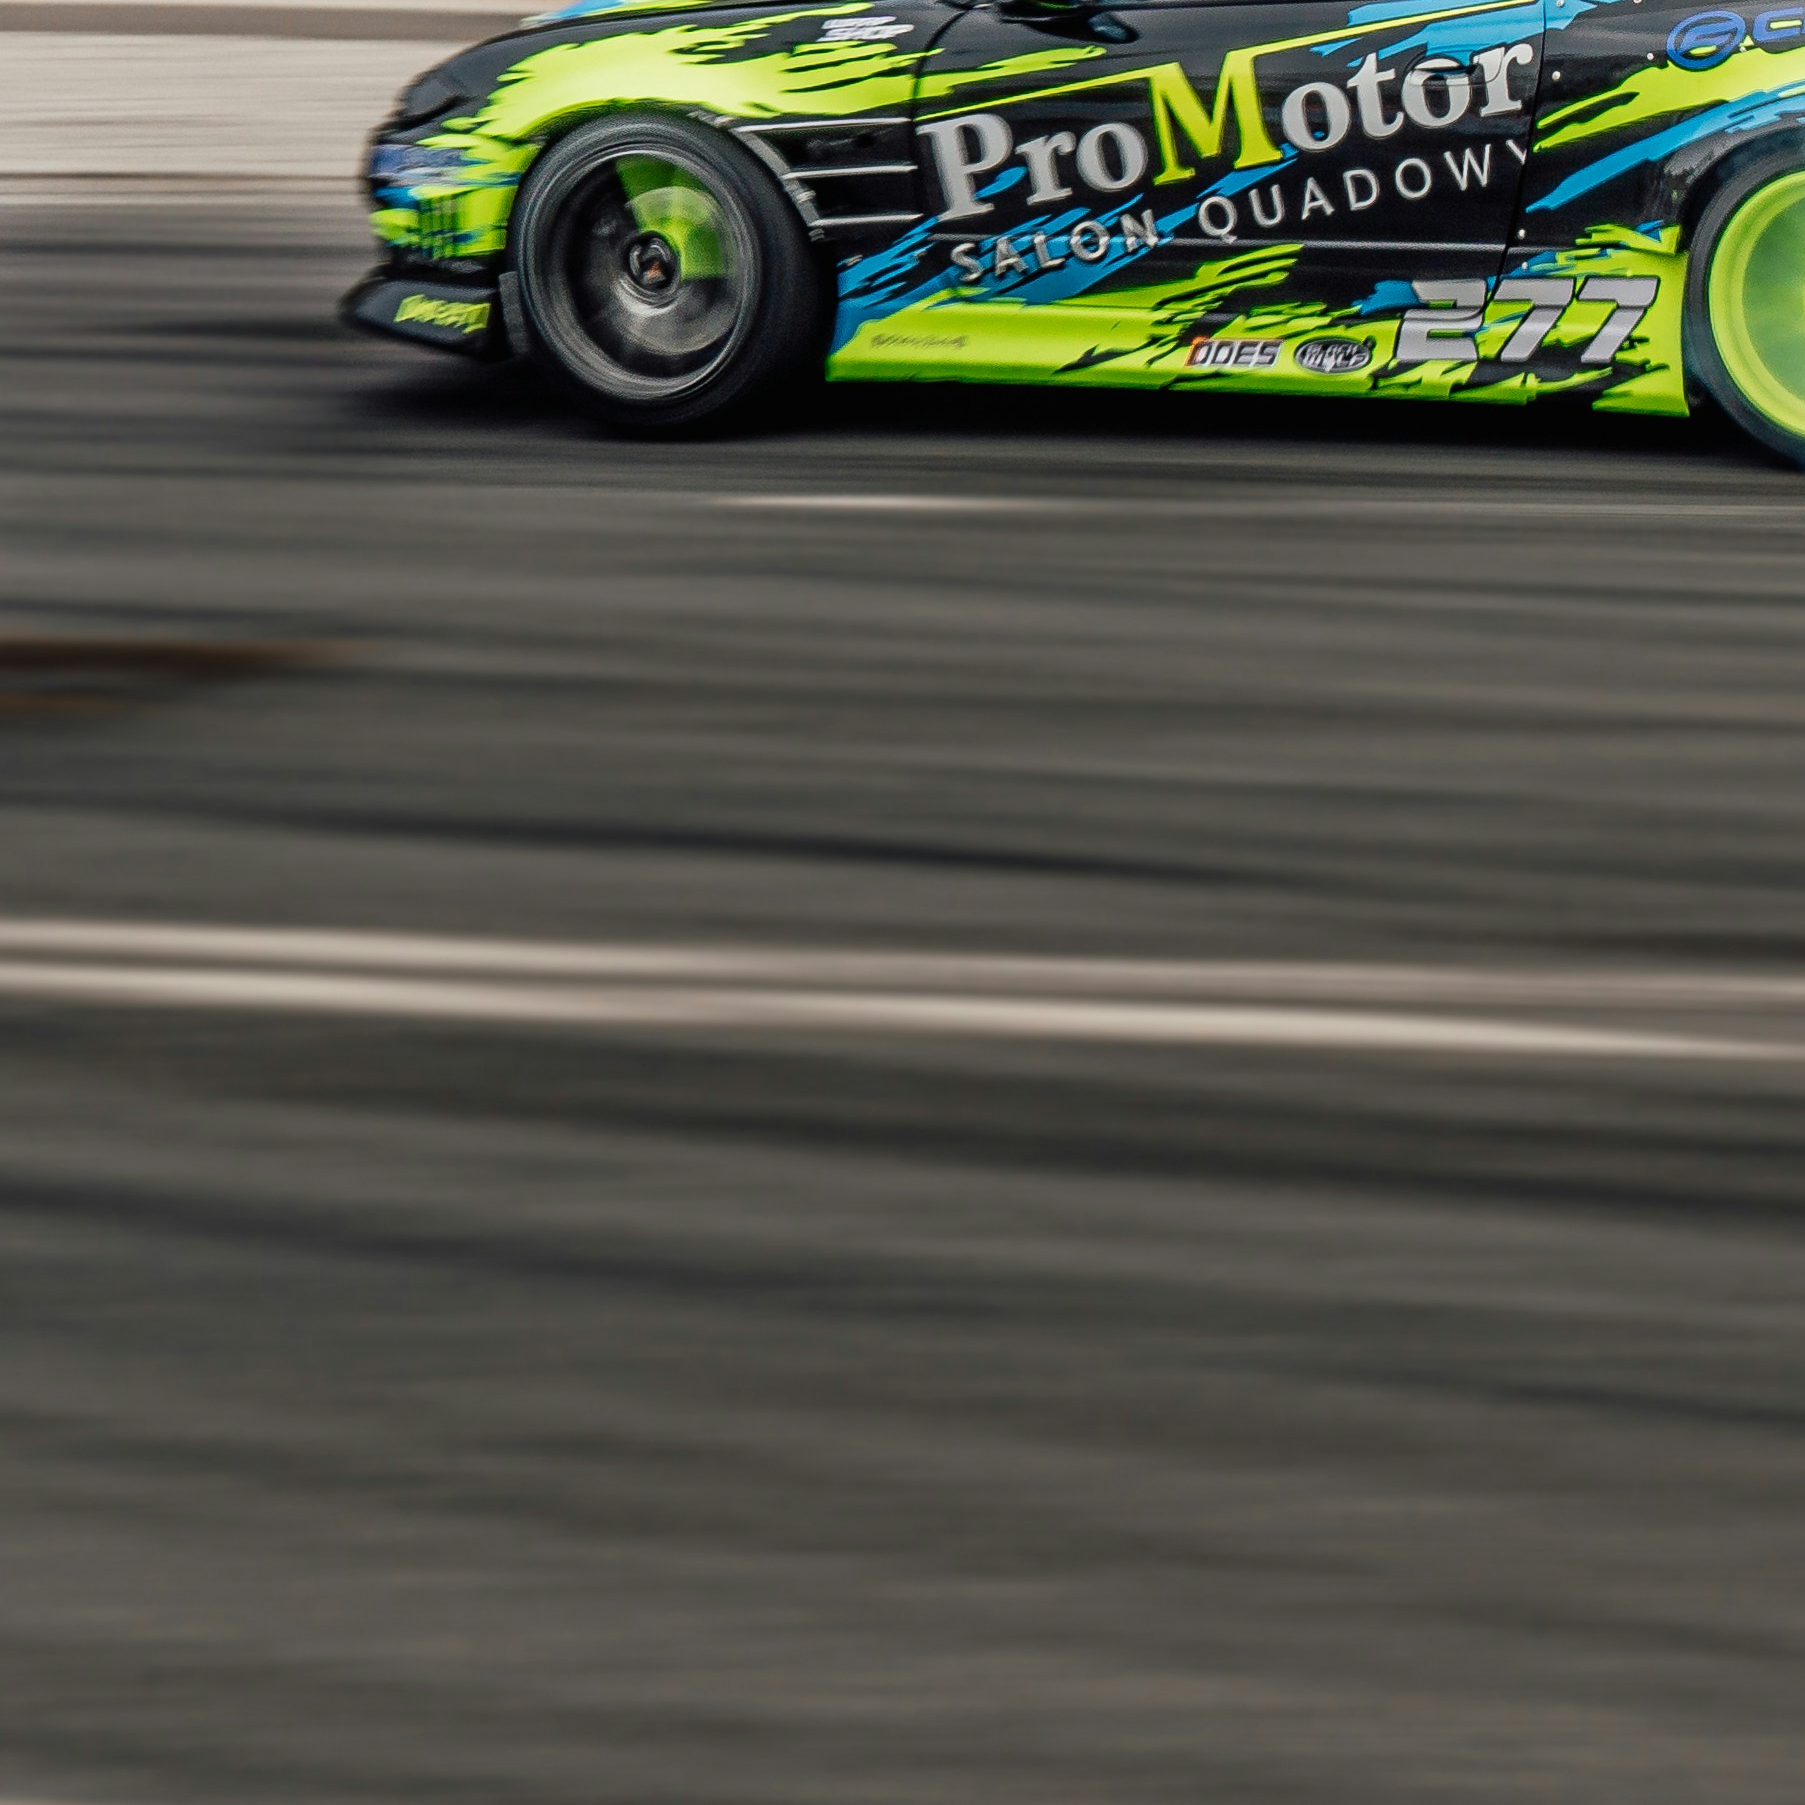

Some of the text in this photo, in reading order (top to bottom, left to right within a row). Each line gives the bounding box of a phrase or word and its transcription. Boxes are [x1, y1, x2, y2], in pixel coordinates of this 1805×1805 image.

[916, 42, 1534, 222] ProMotor
[950, 208, 1160, 283] SALON
[1396, 275, 1659, 363] 277
